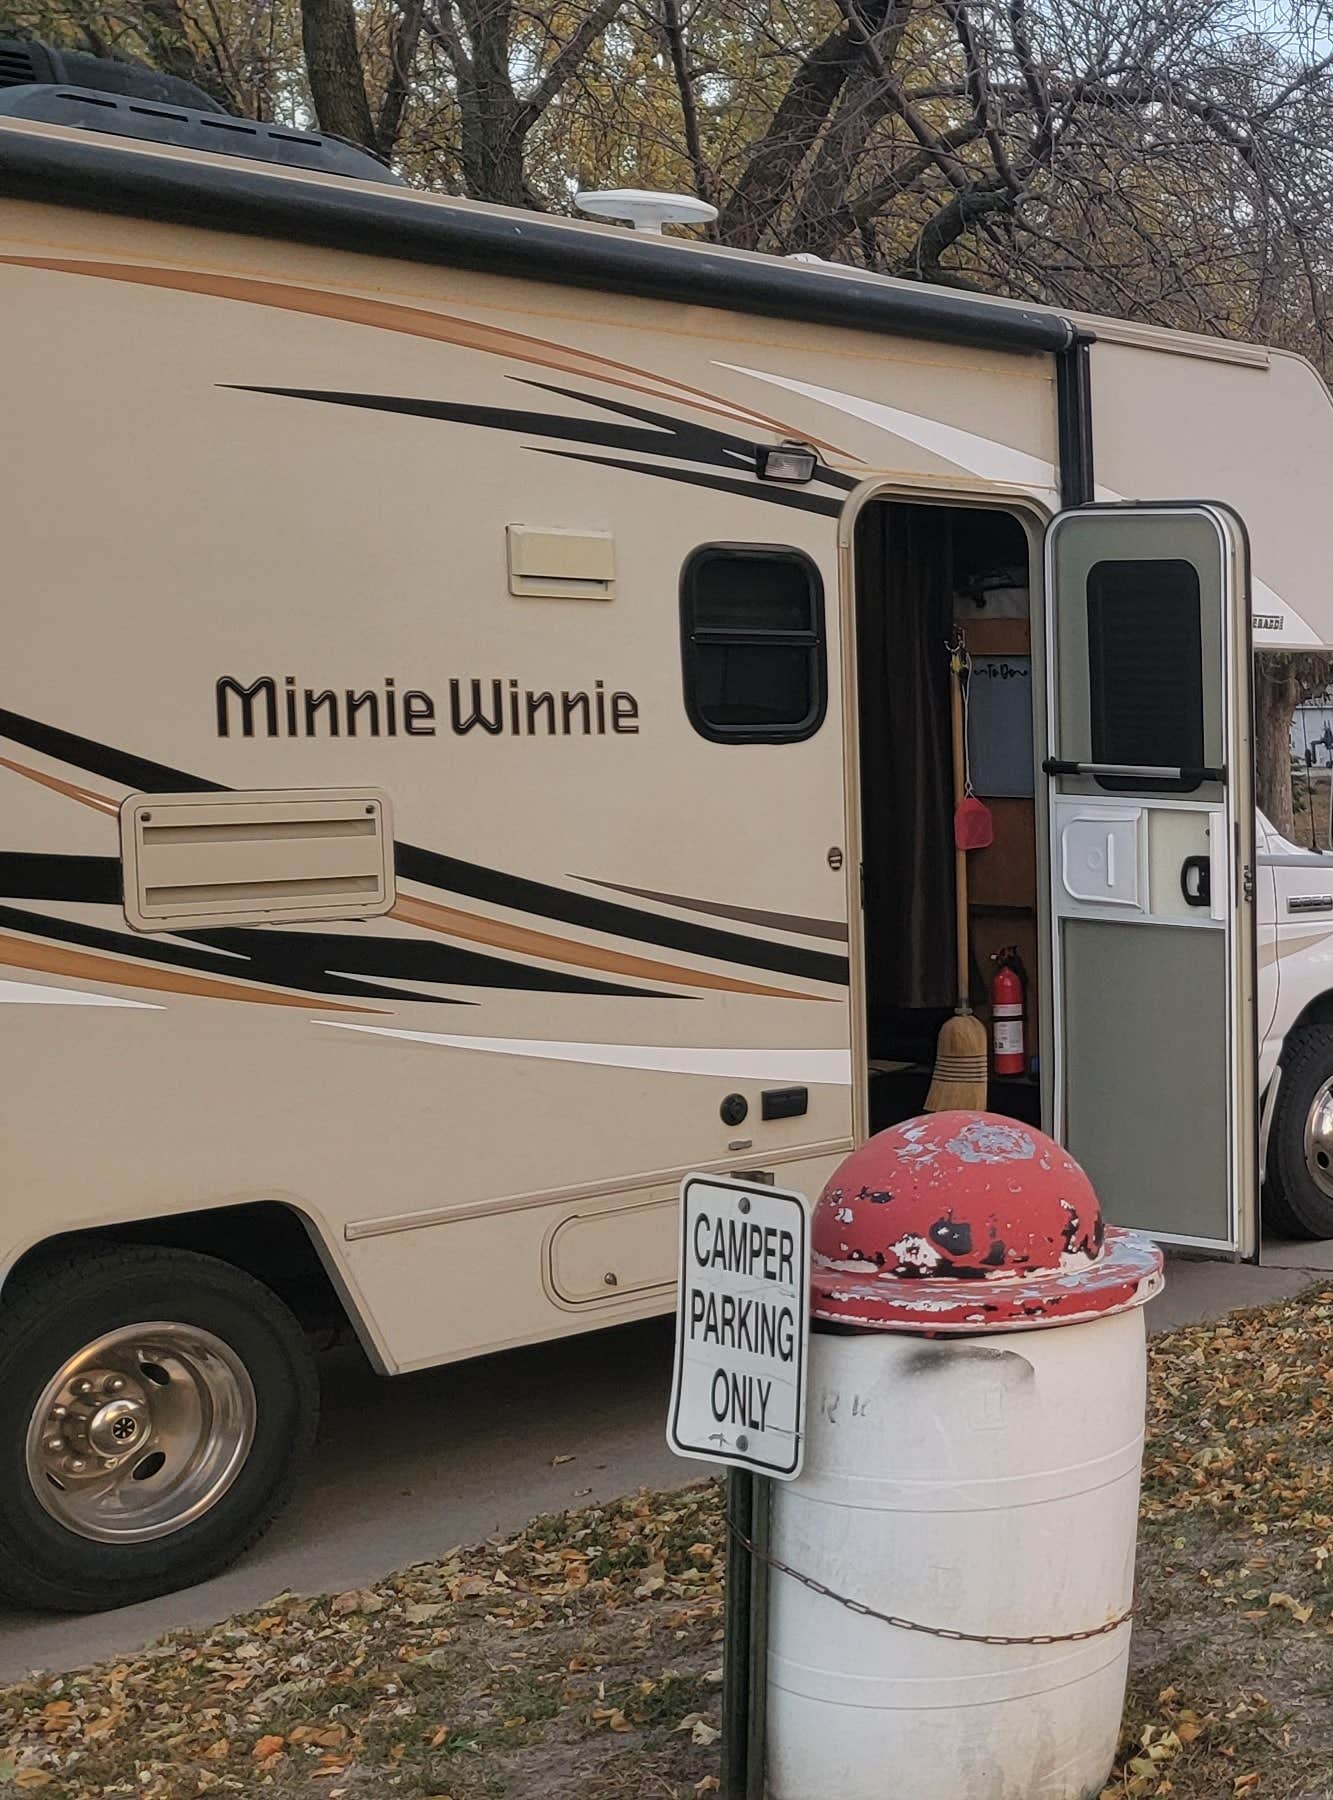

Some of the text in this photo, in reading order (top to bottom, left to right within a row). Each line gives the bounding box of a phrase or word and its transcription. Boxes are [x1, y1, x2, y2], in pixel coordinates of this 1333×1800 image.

[216, 676, 640, 737] Minnie Winnie
[694, 1213, 794, 1284] CAMPER
[690, 1288, 794, 1362] PARKING
[711, 1367, 772, 1432] ONLY
